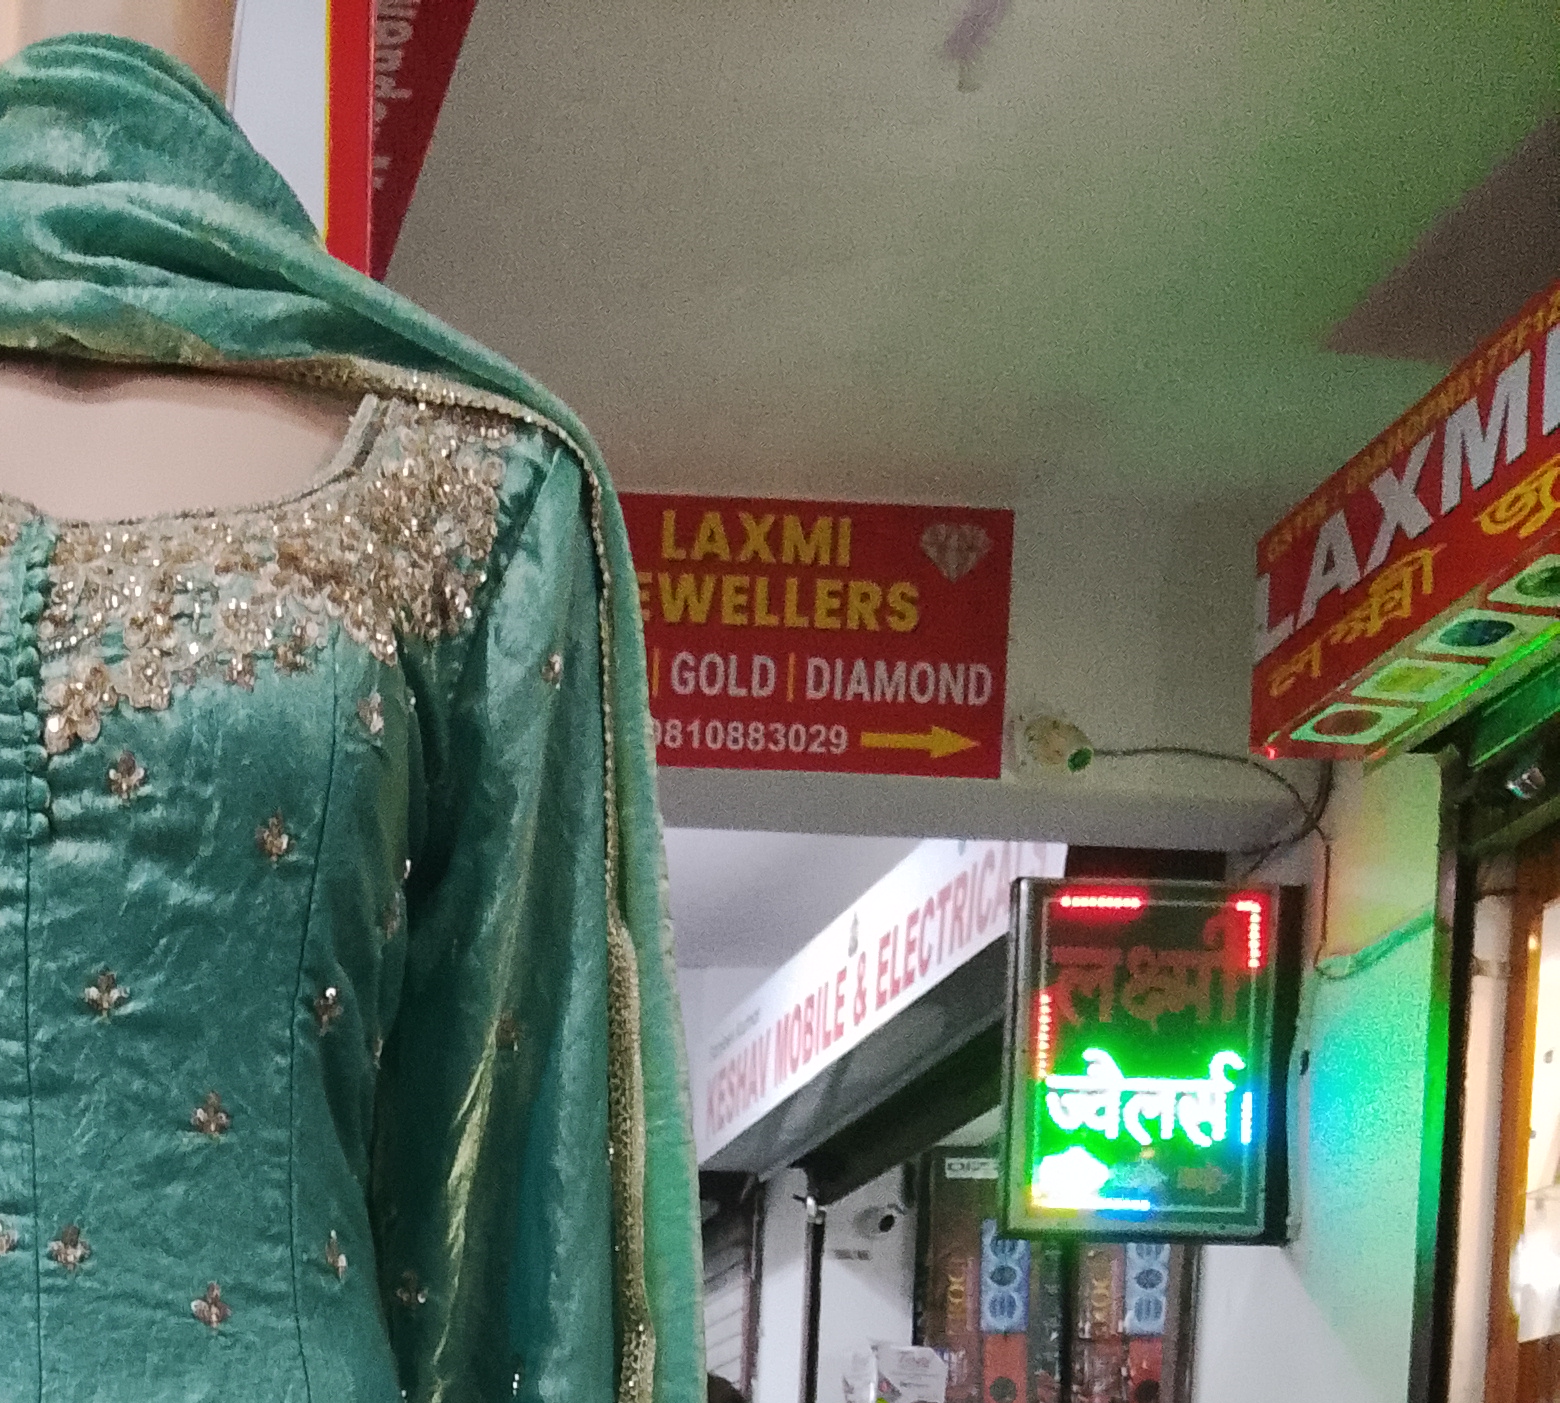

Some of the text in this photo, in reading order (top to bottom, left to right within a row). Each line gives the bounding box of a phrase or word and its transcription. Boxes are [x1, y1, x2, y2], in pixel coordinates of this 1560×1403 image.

[1252, 324, 1560, 665] LAXMI
[661, 509, 852, 568] LAXMI
[639, 571, 920, 633] EWELLERS
[671, 651, 992, 706] GOLD DIAMOND
[705, 1026, 772, 1138] KESHAV
[774, 966, 847, 1088] MOBILE
[853, 950, 867, 1028] &
